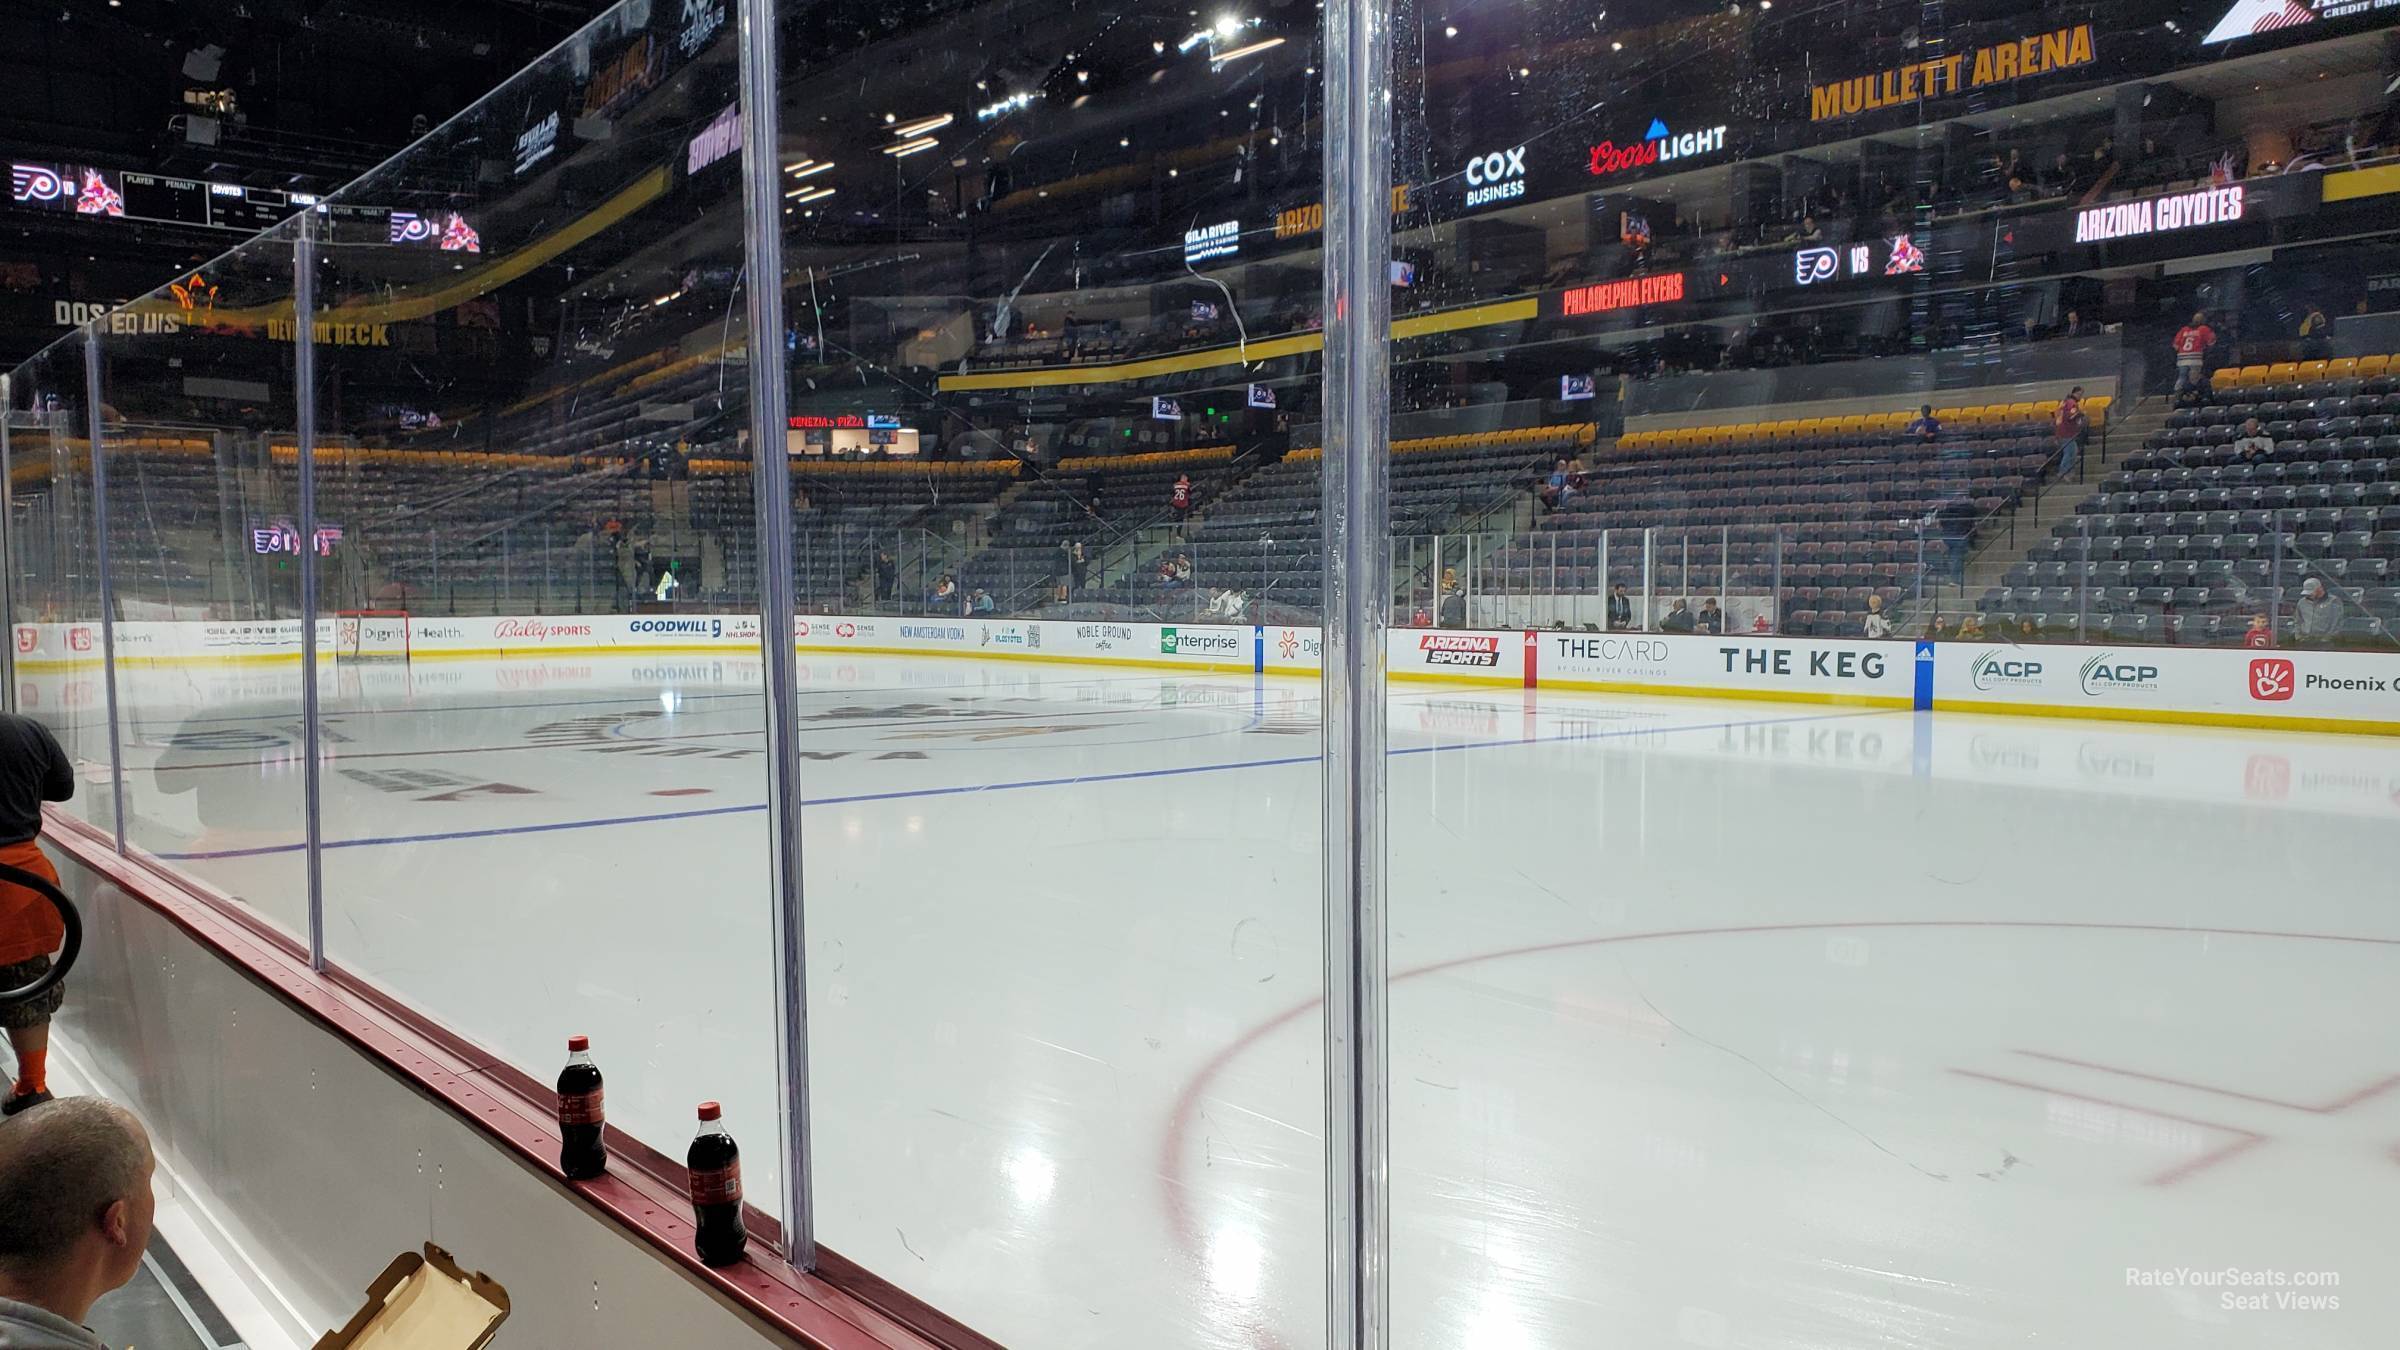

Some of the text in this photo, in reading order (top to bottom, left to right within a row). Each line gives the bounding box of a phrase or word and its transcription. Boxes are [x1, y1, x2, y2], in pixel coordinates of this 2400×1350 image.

[2323, 1, 2370, 18] CREDIT
[1811, 23, 2095, 121] MULLETT ARENA
[1590, 126, 1727, 175] Coors LIGHT
[1466, 146, 1526, 186] COX
[127, 175, 196, 191] PLAYER PENALTY
[212, 184, 242, 197] COYOTES
[1467, 179, 1525, 206] BUSINESS
[1276, 203, 1323, 239] ARIZO
[2076, 185, 2244, 243] ARIZONA COYOTES
[1185, 220, 1239, 244] GILA RIVER
[1850, 247, 1869, 274] VS
[1563, 272, 1684, 316] PHILADELPHIA FLYERS
[55, 300, 105, 326] DOS
[335, 323, 389, 347] DECK
[837, 415, 864, 427] PIZZA
[494, 618, 592, 641] Bally SPORTS
[630, 620, 708, 633] GOODWILL
[811, 623, 830, 631] SENSE
[857, 624, 875, 632] SENSE
[900, 625, 965, 641] NEW AMSTERDAM VODKA
[1076, 625, 1132, 640] NOBLE GROUND
[1095, 640, 1112, 650] coffee
[1166, 634, 1237, 650] enterprise
[1423, 636, 1491, 651] ARIZONA
[1430, 651, 1494, 666] SPORTS
[1720, 647, 1885, 679] THE KEG
[1557, 665, 1567, 673] BY
[1572, 665, 1592, 673] GILA
[1596, 666, 1622, 674] RIVER
[1983, 661, 2043, 678] ACP
[2091, 664, 2158, 682] ACP
[2306, 674, 2386, 692] Phoenix
